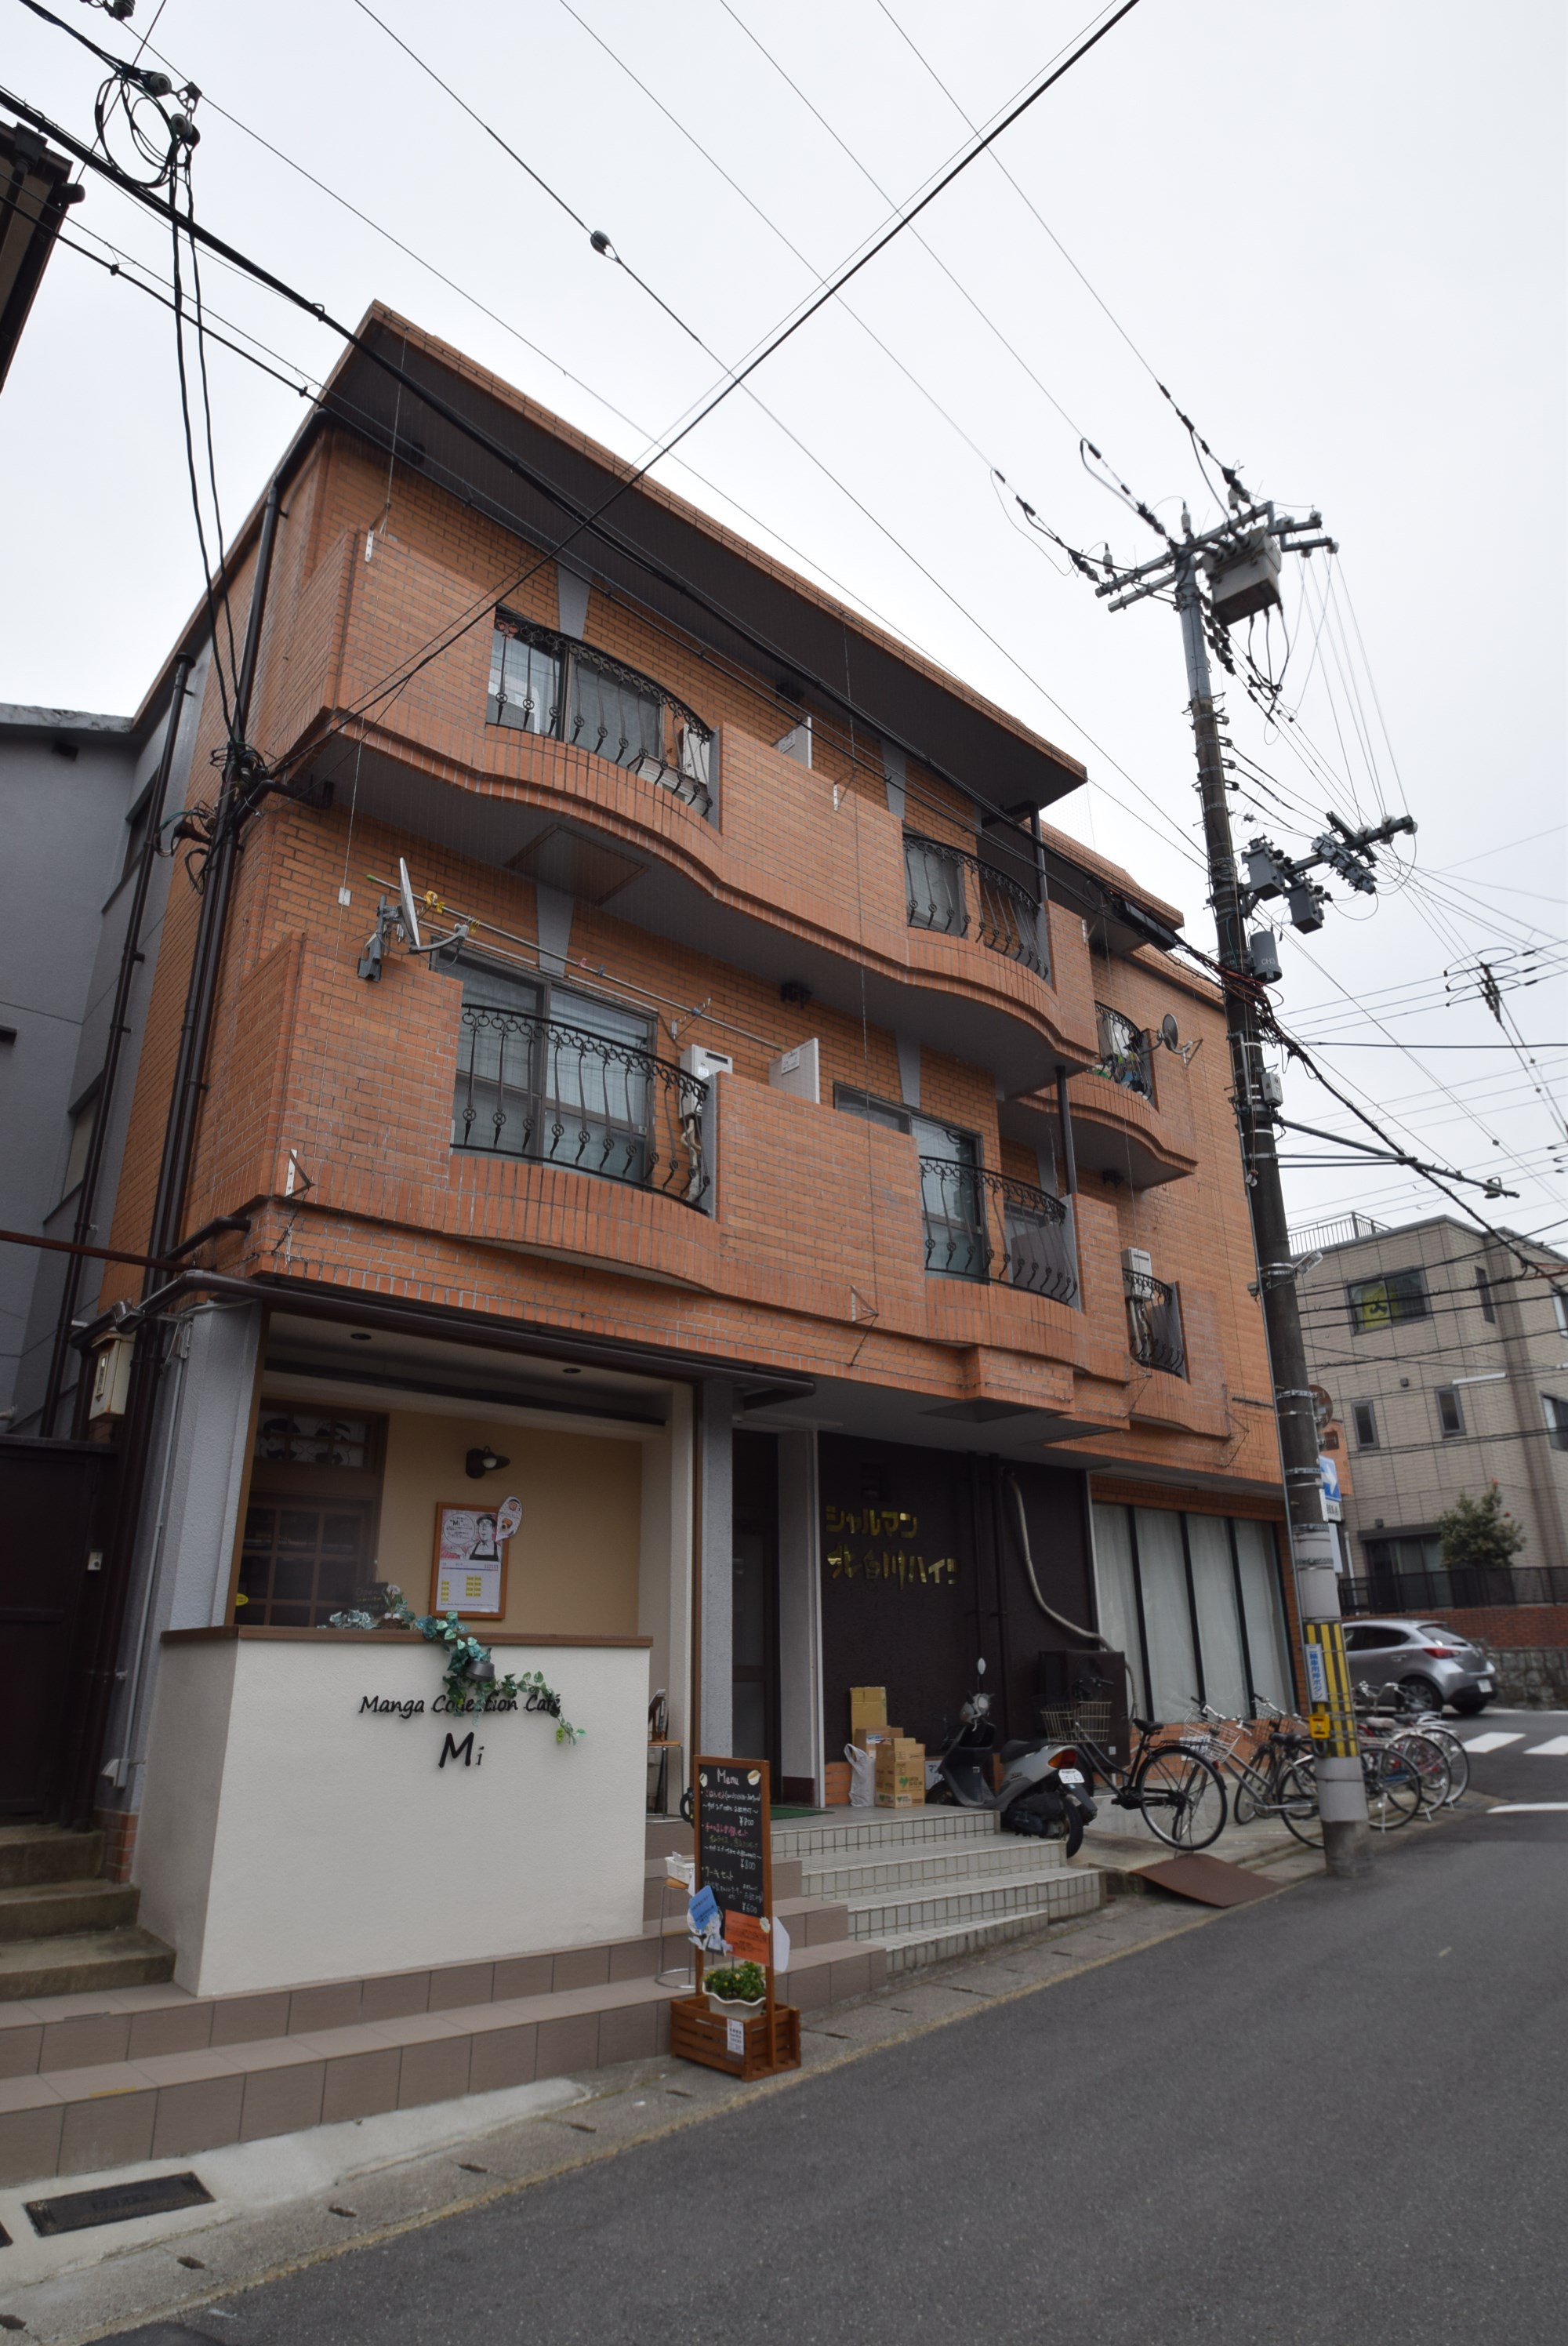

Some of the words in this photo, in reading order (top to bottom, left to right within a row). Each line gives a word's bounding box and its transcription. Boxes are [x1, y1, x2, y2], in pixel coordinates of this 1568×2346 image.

[825, 1505, 918, 1539] シャルマン
[358, 1695, 425, 1720] Manga
[437, 1730, 485, 1769] Mi
[717, 1767, 740, 1786] Menu
